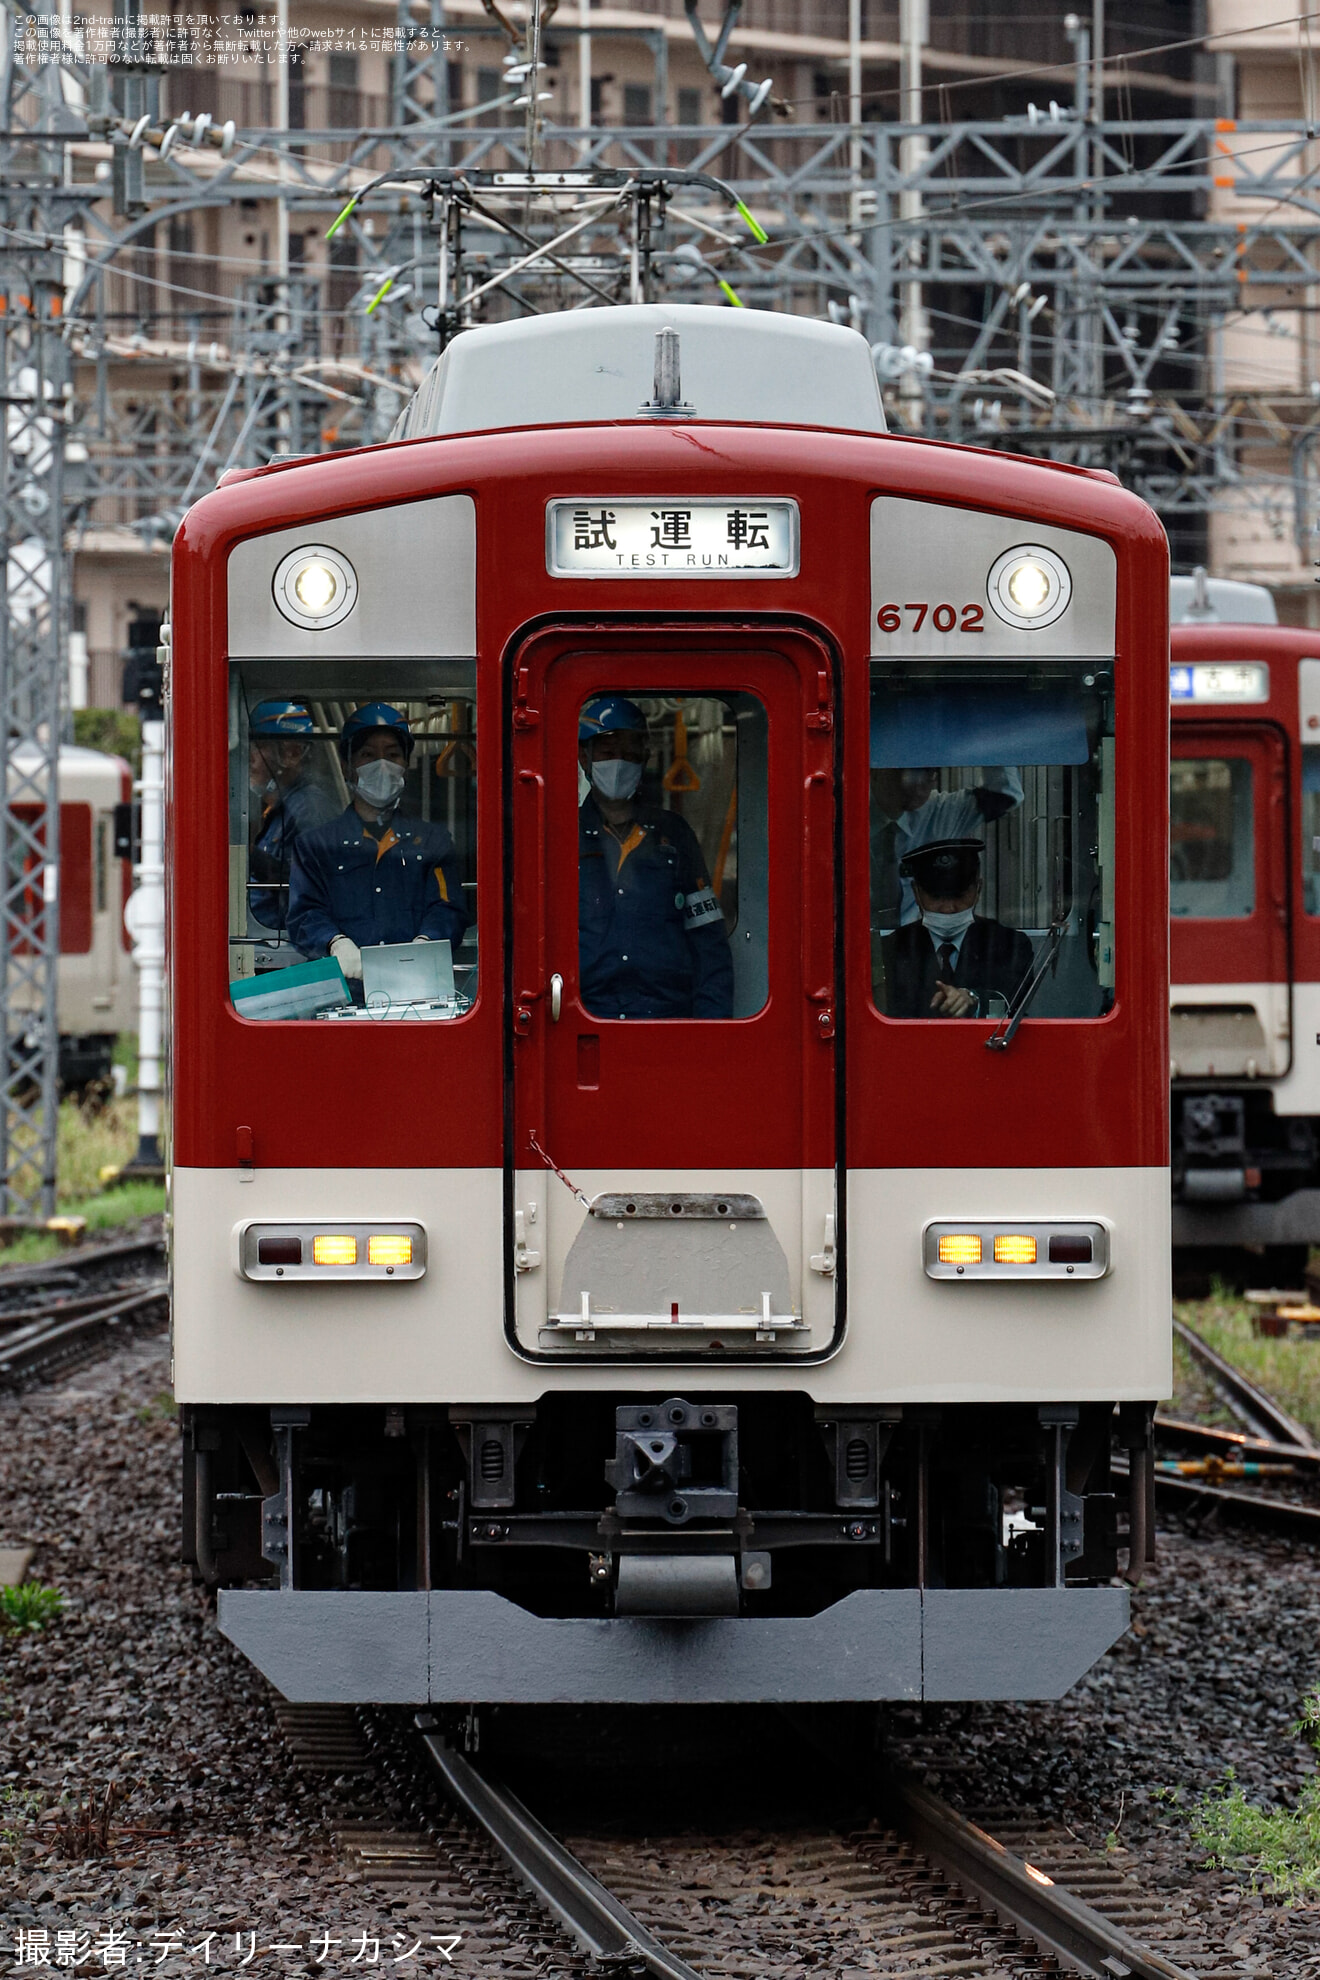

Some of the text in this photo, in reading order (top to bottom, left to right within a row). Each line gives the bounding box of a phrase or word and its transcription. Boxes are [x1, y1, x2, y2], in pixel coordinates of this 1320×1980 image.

[573, 509, 770, 551] 試運転
[616, 553, 729, 566] TEST RUN
[877, 603, 984, 633] 6702
